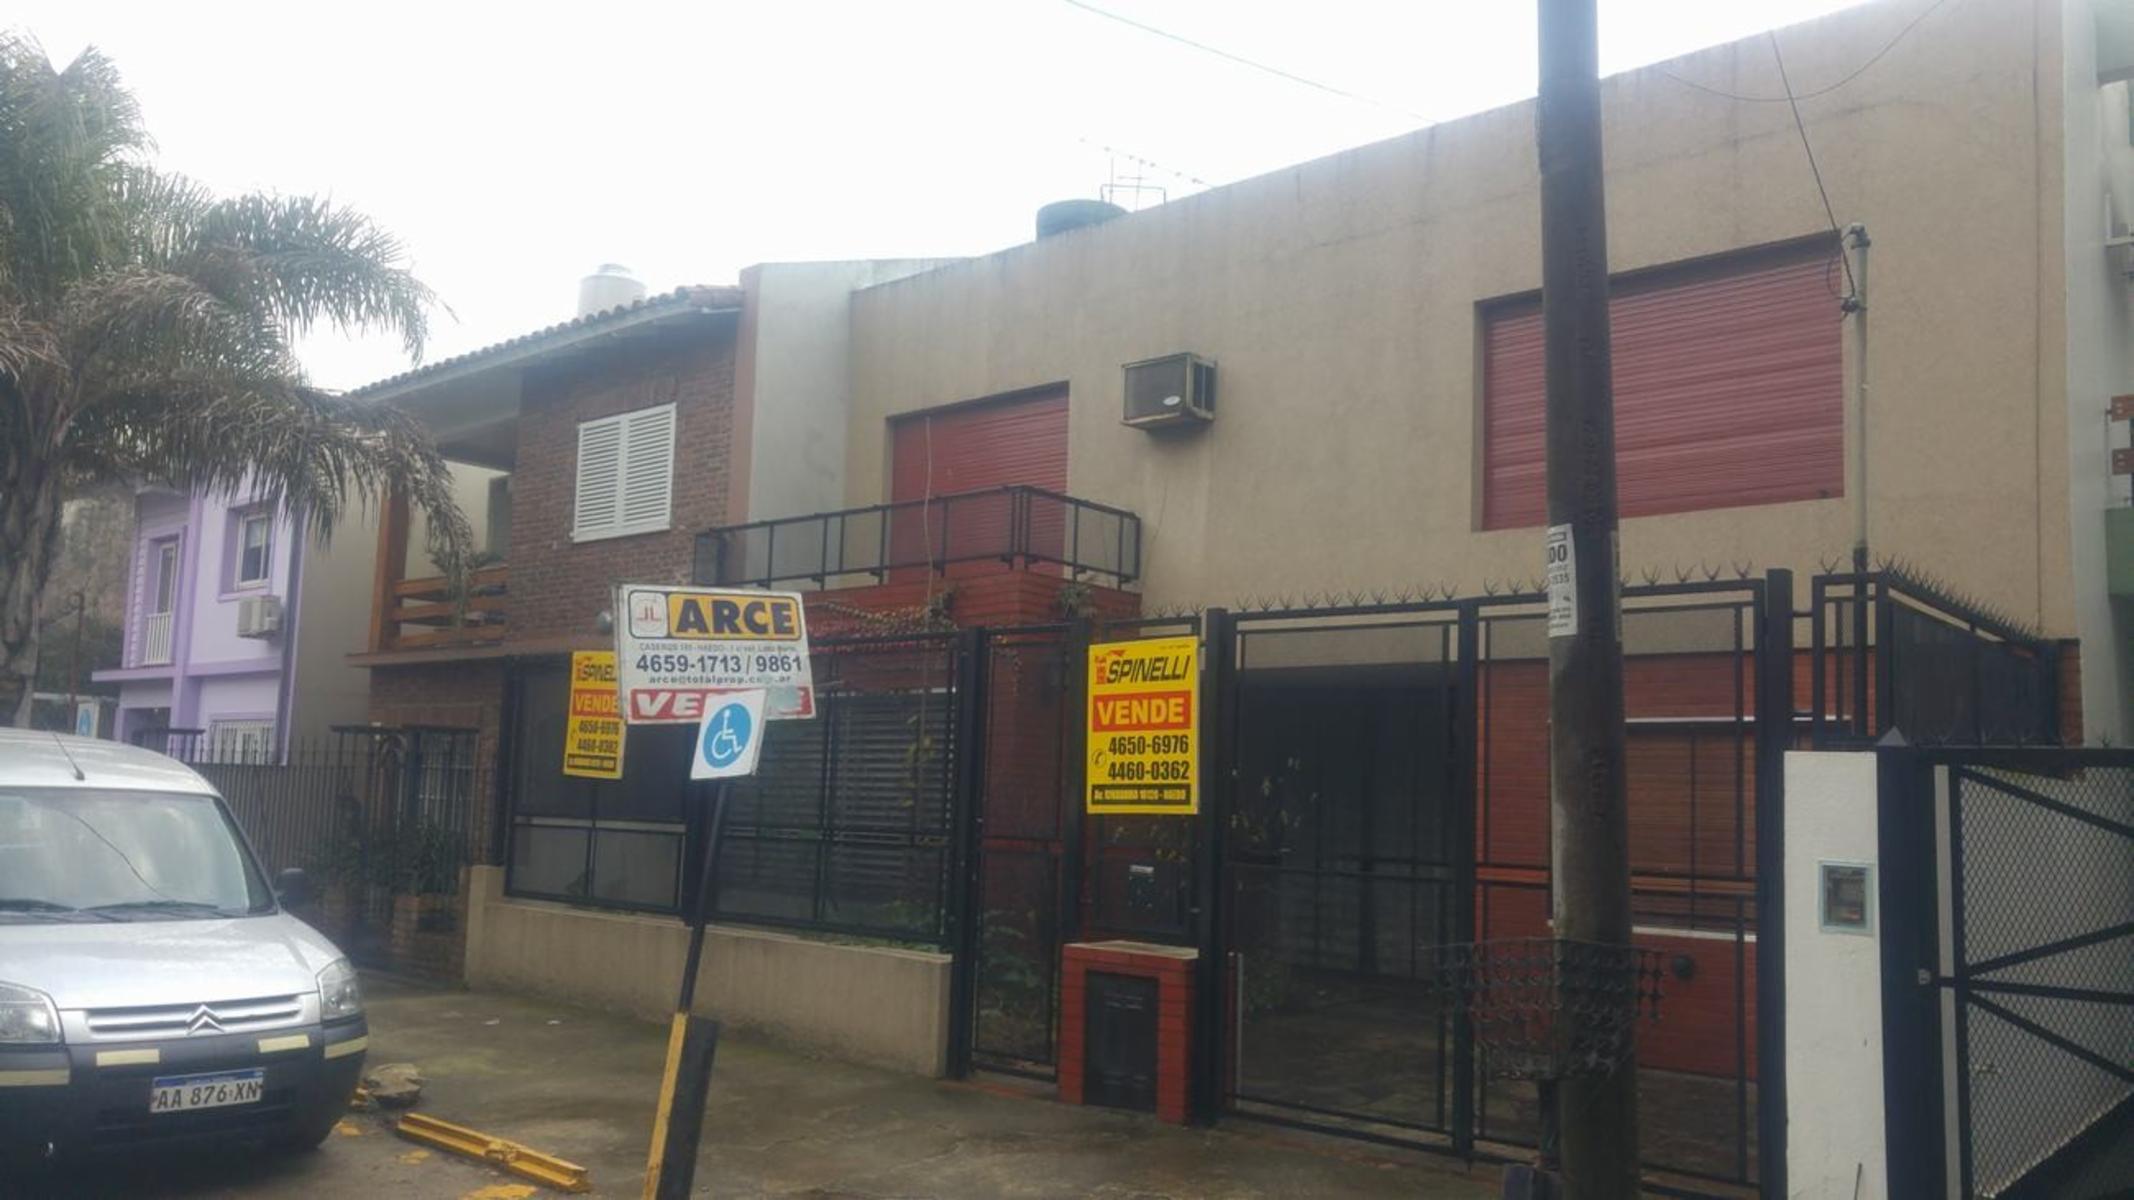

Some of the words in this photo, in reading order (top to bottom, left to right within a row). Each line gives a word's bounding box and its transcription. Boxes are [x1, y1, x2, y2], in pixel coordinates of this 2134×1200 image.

[676, 599, 795, 634] ARCE
[636, 654, 741, 672] 4659-1713
[756, 655, 801, 673] 9861
[1107, 655, 1190, 683] SPINELLI
[1097, 697, 1184, 725] VENDE
[1109, 735, 1189, 755] 4650-6976
[1108, 761, 1190, 780] 4460-0362
[157, 1089, 182, 1109] AA
[191, 1084, 228, 1105] 876
[234, 1081, 257, 1101] XN
